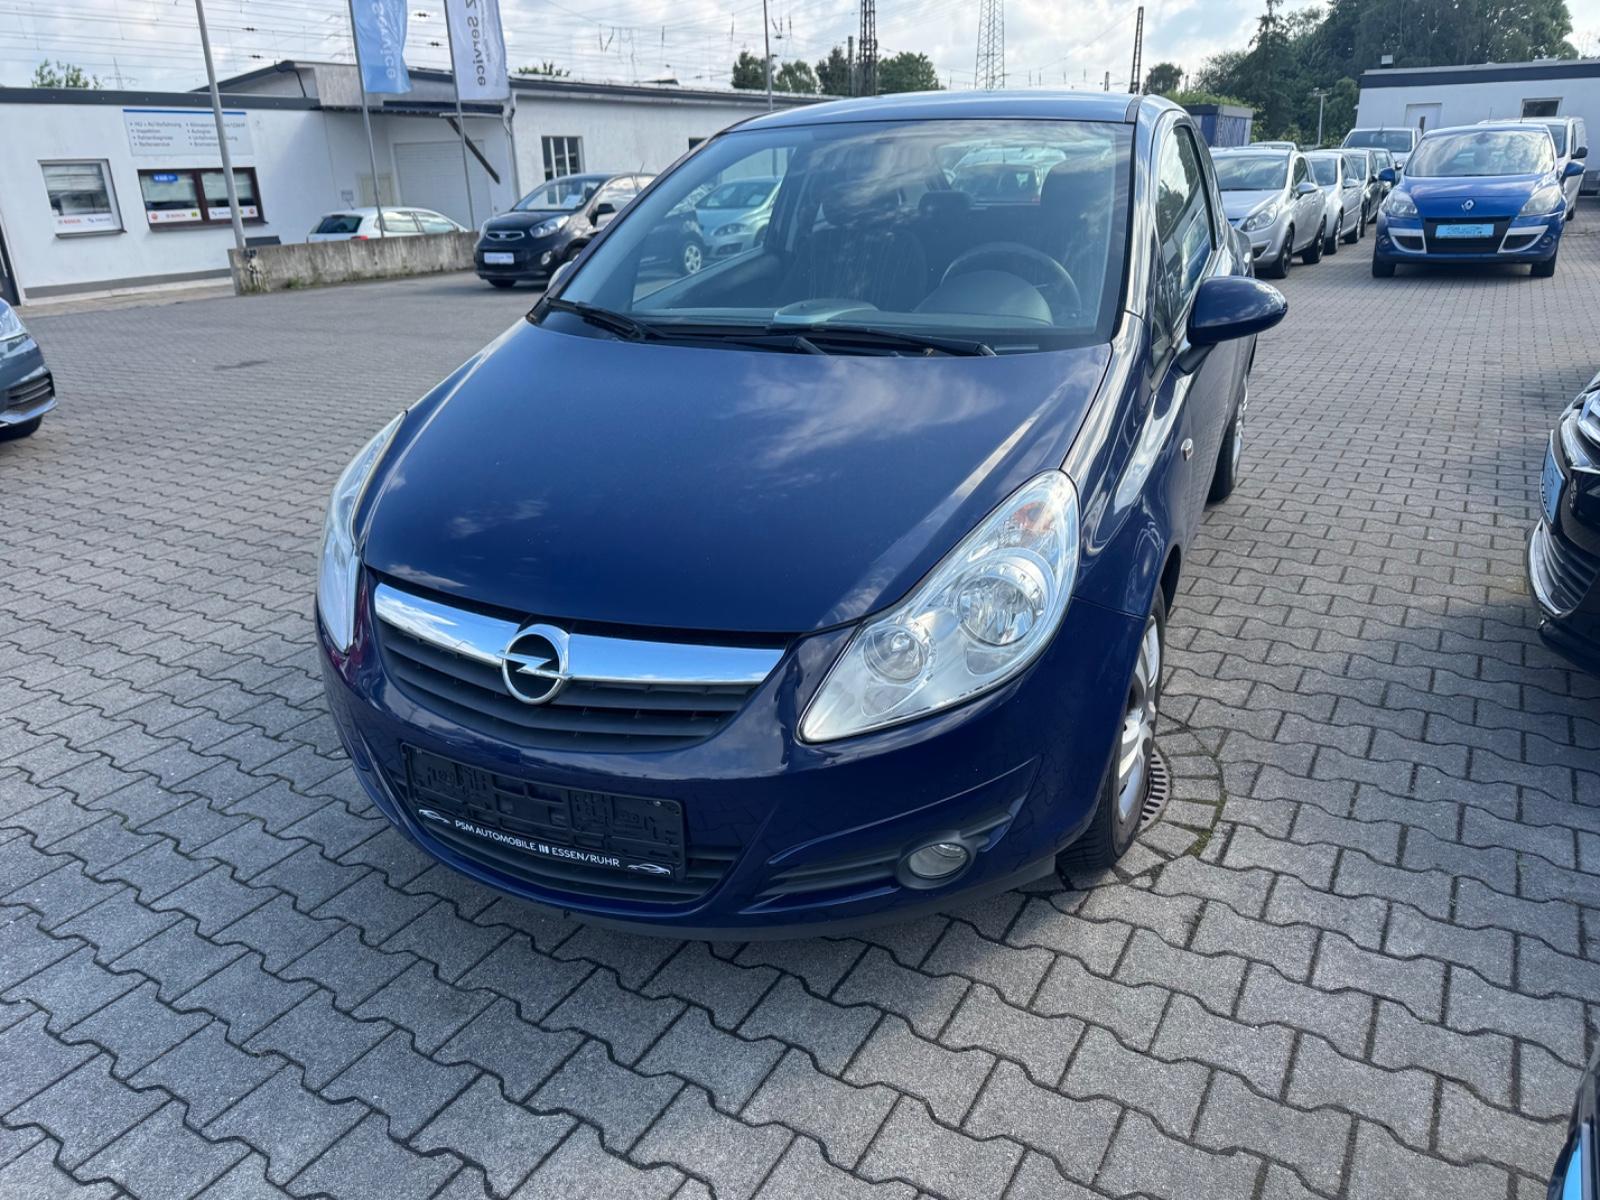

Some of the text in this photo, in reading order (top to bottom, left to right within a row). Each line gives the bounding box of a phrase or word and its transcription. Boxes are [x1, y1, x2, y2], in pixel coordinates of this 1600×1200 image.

[455, 819, 621, 867] PSM AUTOMOBILE ESSEN/RUHR
